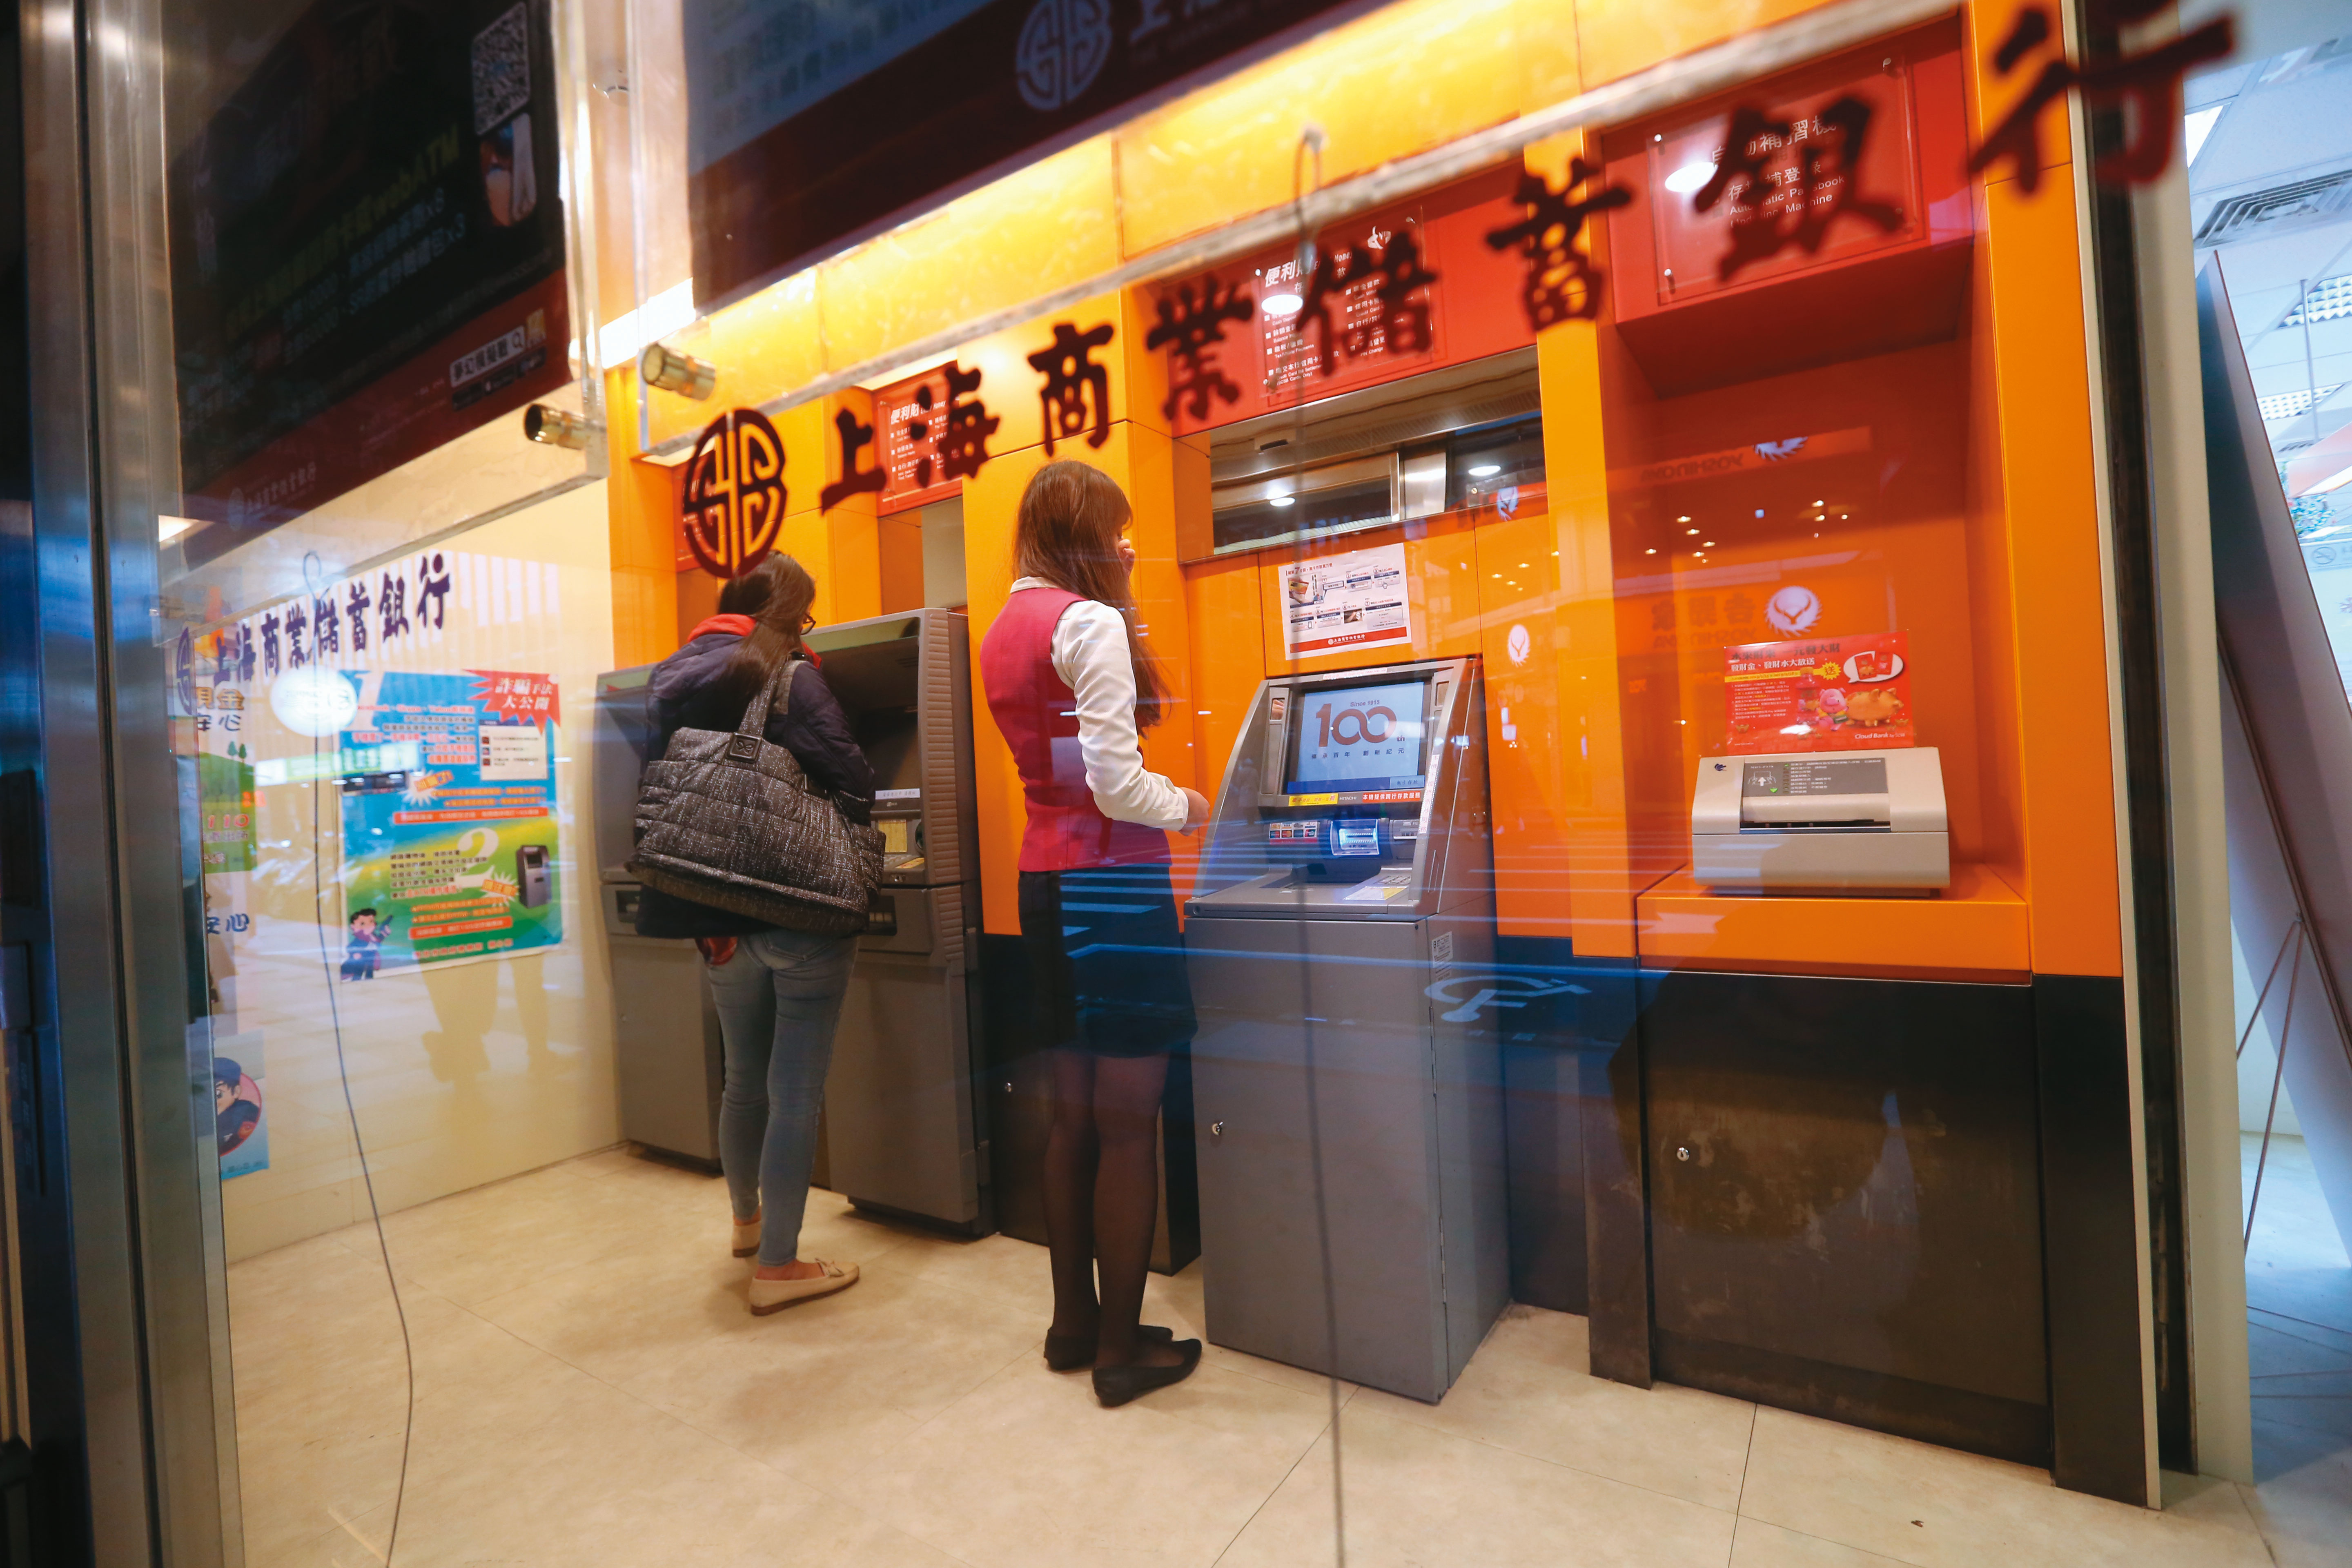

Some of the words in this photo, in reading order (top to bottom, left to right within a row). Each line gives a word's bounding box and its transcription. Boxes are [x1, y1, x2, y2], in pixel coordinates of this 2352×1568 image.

[820, 0, 2237, 516] 上海商業儲蓄銀行
[1316, 703, 1397, 748] 100
[1311, 751, 1350, 760] 傳承百年
[1363, 748, 1405, 756] 創新紀元
[1363, 792, 1421, 800] 本機提供跨行存款服務
